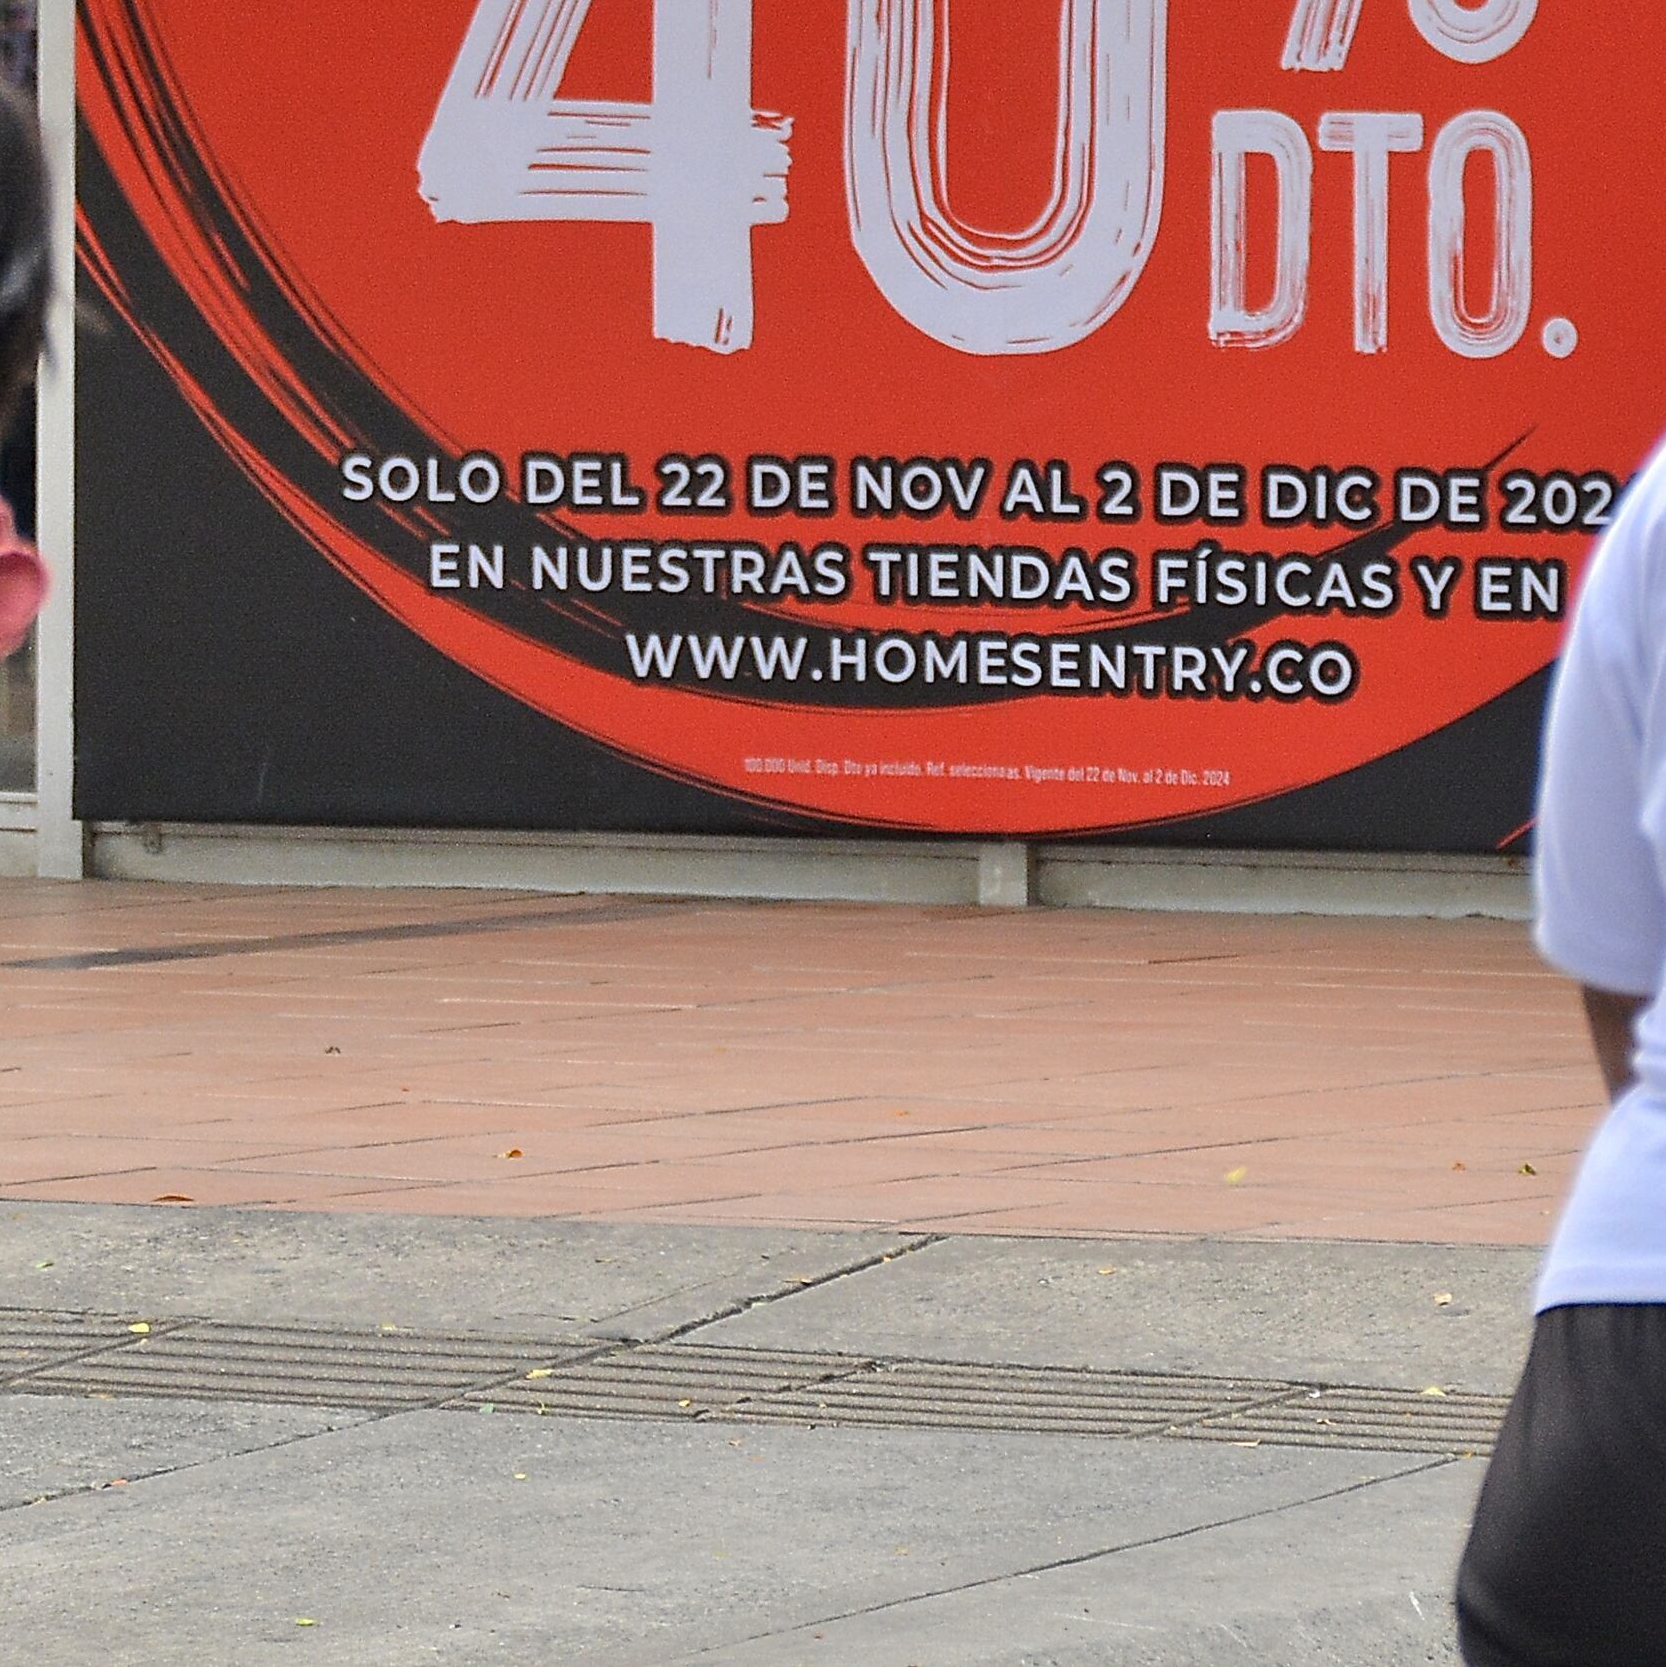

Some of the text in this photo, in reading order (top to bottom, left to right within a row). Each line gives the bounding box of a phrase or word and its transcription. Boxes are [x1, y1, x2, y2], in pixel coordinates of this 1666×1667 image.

[1209, 109, 1579, 360] DTO.
[341, 456, 1614, 527] SOLO DEL 22 DE NOV AL 2 DE DIC DE 202
[432, 543, 1560, 613] EN NUESTRAS TIENDAS FÍSICAS Y EN
[625, 634, 1353, 697] WWW.HOMESENTRY.CO
[1024, 765, 1065, 783] Vigente
[1067, 766, 1084, 782] del
[1086, 767, 1100, 782] 22
[1102, 767, 1116, 783] de
[1118, 768, 1141, 784] Nov.
[1143, 769, 1153, 784] al
[1154, 770, 1163, 784] 2
[1165, 769, 1179, 785] de
[1181, 770, 1200, 785] Dic.
[1203, 770, 1231, 787] 2024
